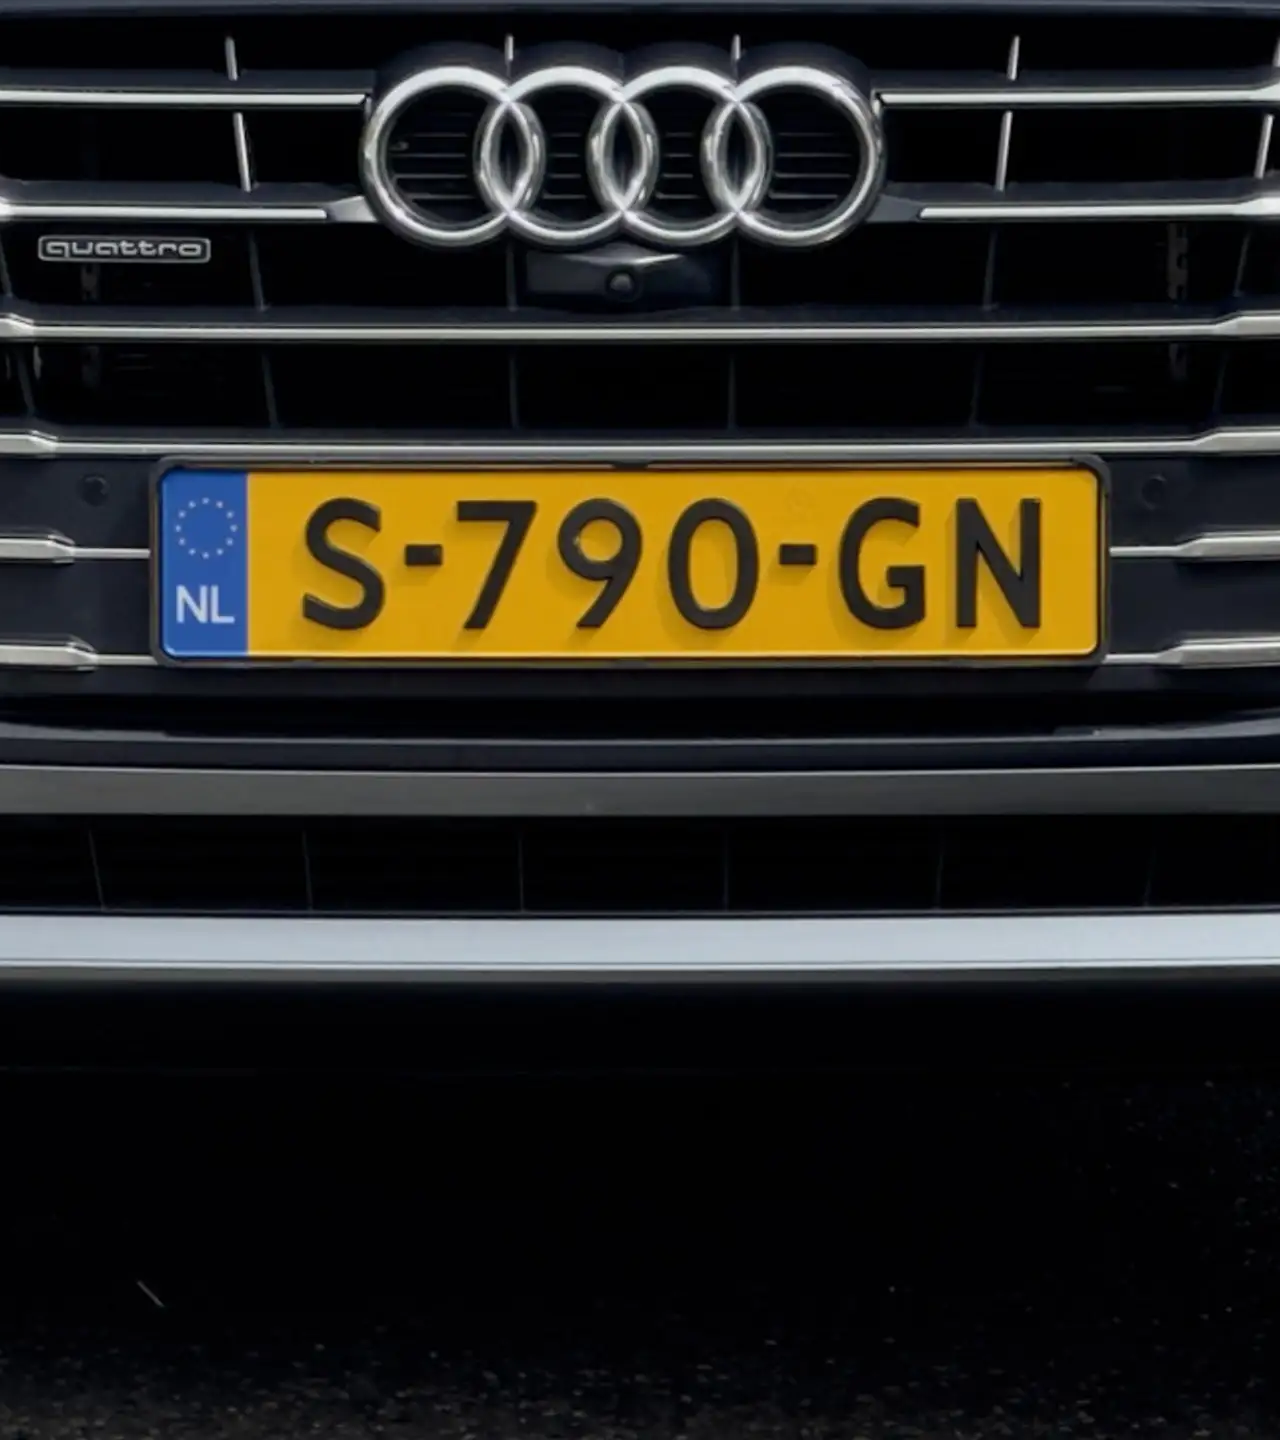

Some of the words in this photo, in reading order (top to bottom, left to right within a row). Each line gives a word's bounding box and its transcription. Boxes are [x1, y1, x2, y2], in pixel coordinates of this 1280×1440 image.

[46, 241, 202, 259] quattro
[302, 497, 1042, 630] S-790-GN
[175, 585, 236, 624] NL
